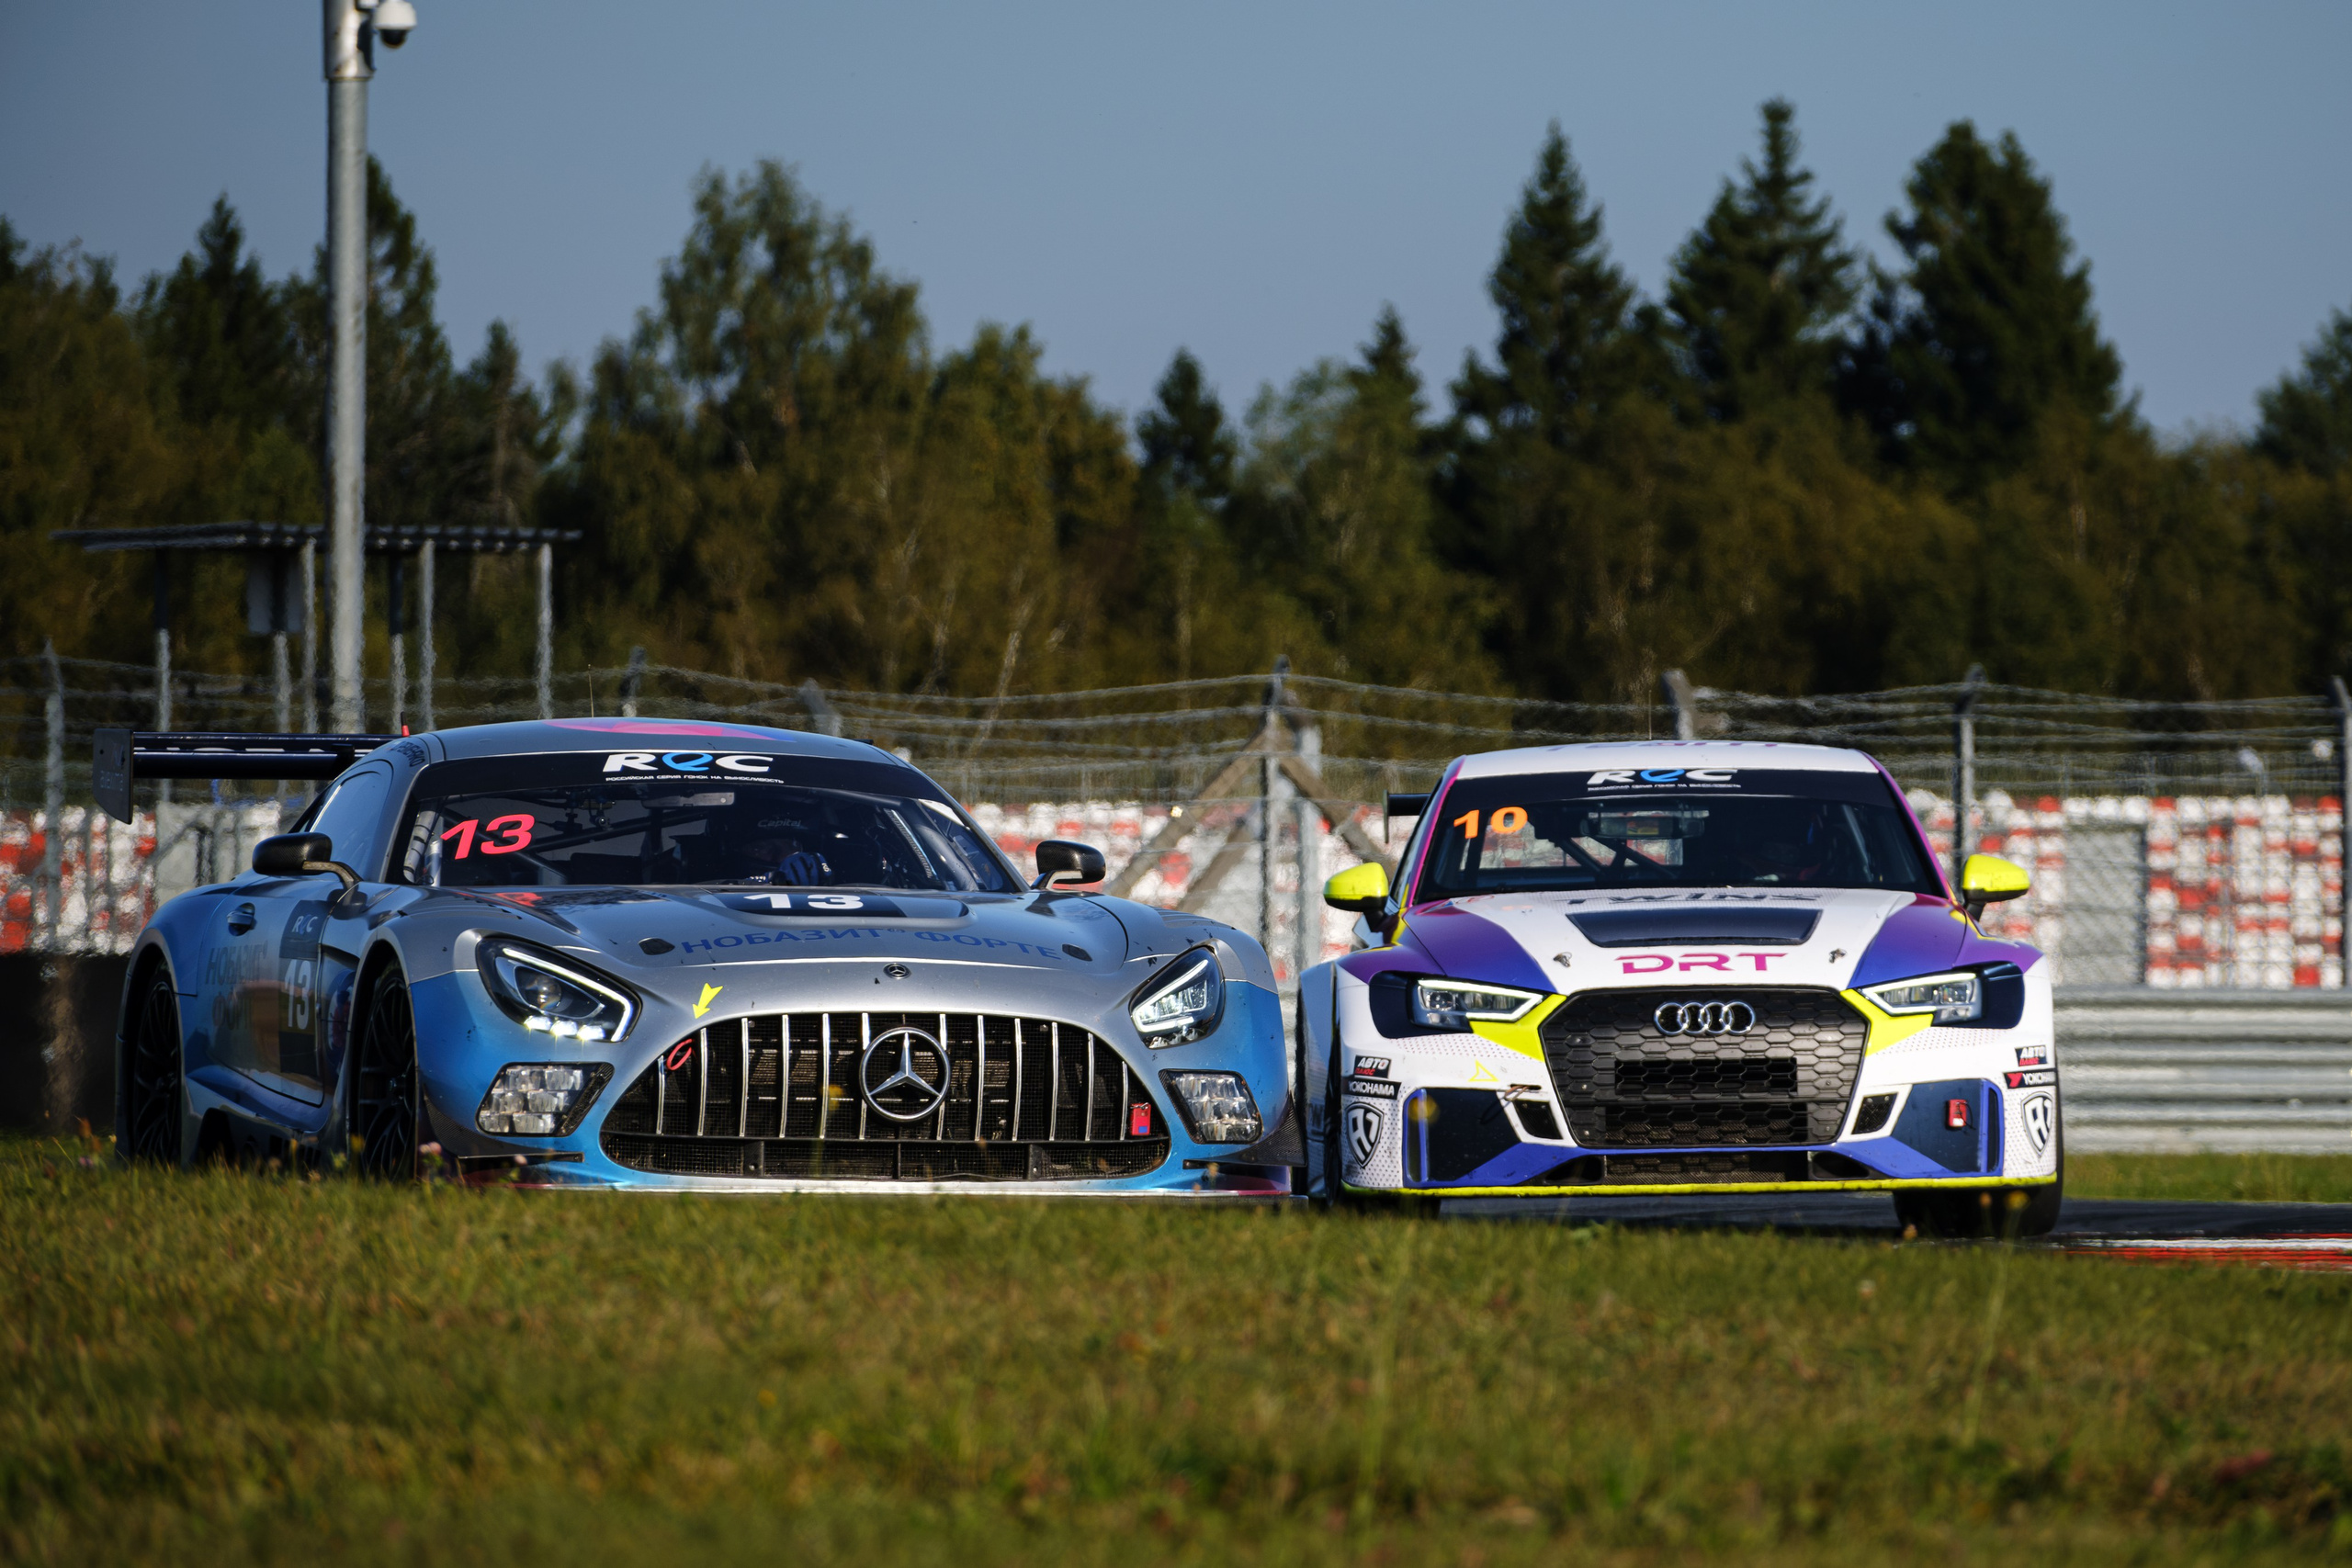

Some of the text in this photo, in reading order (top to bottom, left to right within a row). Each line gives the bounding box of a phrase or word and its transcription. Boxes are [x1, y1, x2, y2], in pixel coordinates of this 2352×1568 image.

[440, 814, 536, 860] 13
[1453, 807, 1529, 839] 10
[743, 894, 864, 909] 13
[914, 931, 1061, 960] ФОРТЕ
[1614, 952, 1789, 975] DRT
[284, 958, 312, 1030] 13
[1349, 1079, 1395, 1097] YOKOHAMA
